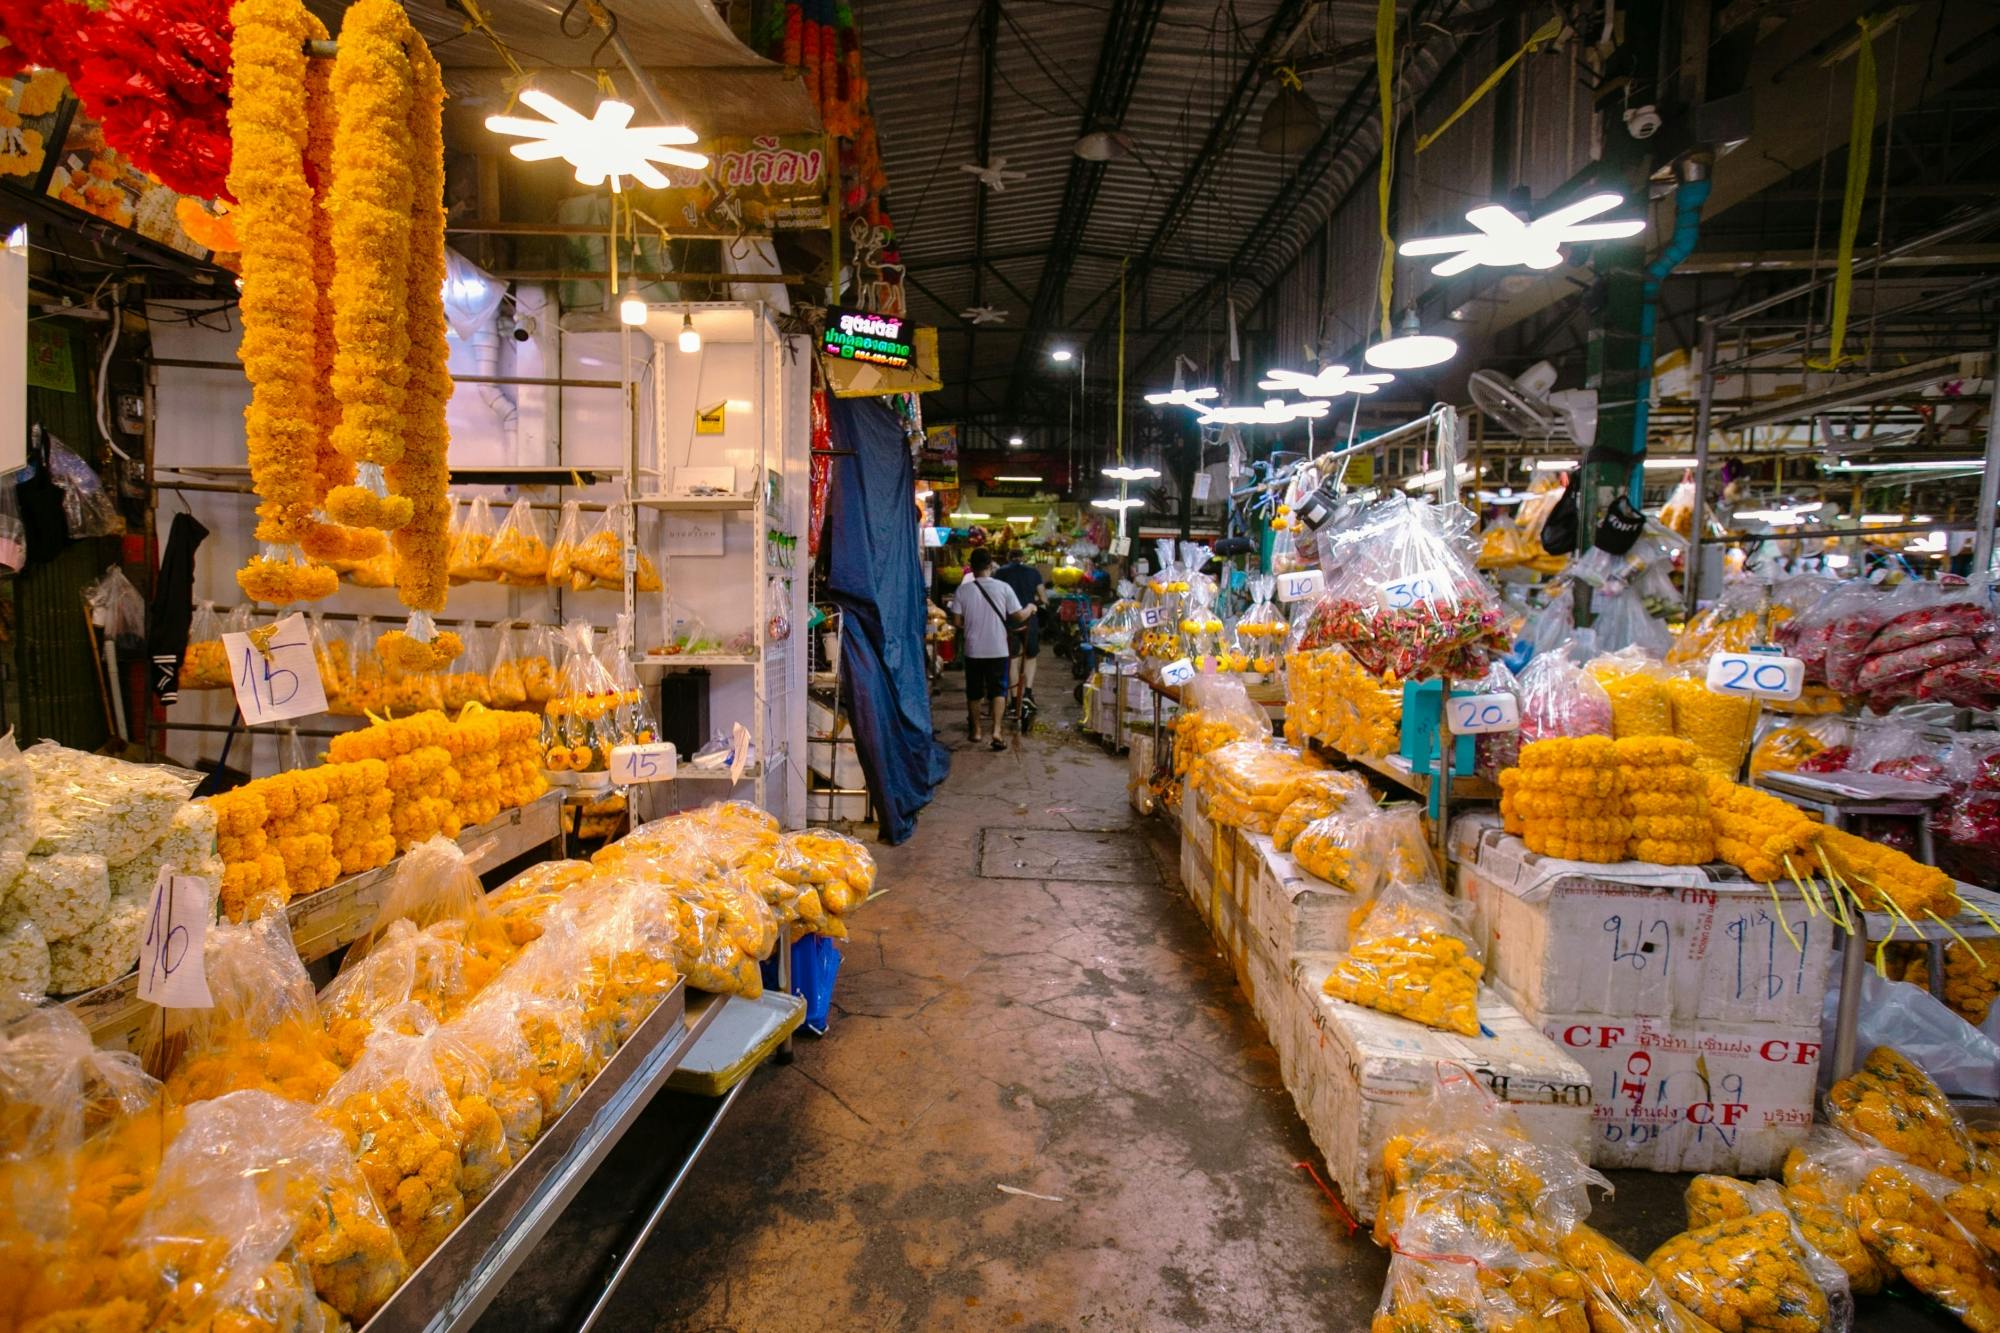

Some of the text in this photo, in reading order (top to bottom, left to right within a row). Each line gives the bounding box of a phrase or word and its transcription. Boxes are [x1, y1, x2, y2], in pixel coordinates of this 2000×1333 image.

[825, 328, 910, 357] ปากคลองตลาด
[1289, 577, 1313, 597] 40
[1386, 580, 1434, 608] 30
[241, 642, 307, 716] 15
[626, 751, 661, 779] 15
[1563, 1025, 1625, 1049] CF
[1759, 1040, 1822, 1065] CF
[1621, 1050, 1652, 1104] CF
[1686, 1102, 1748, 1126] CF
